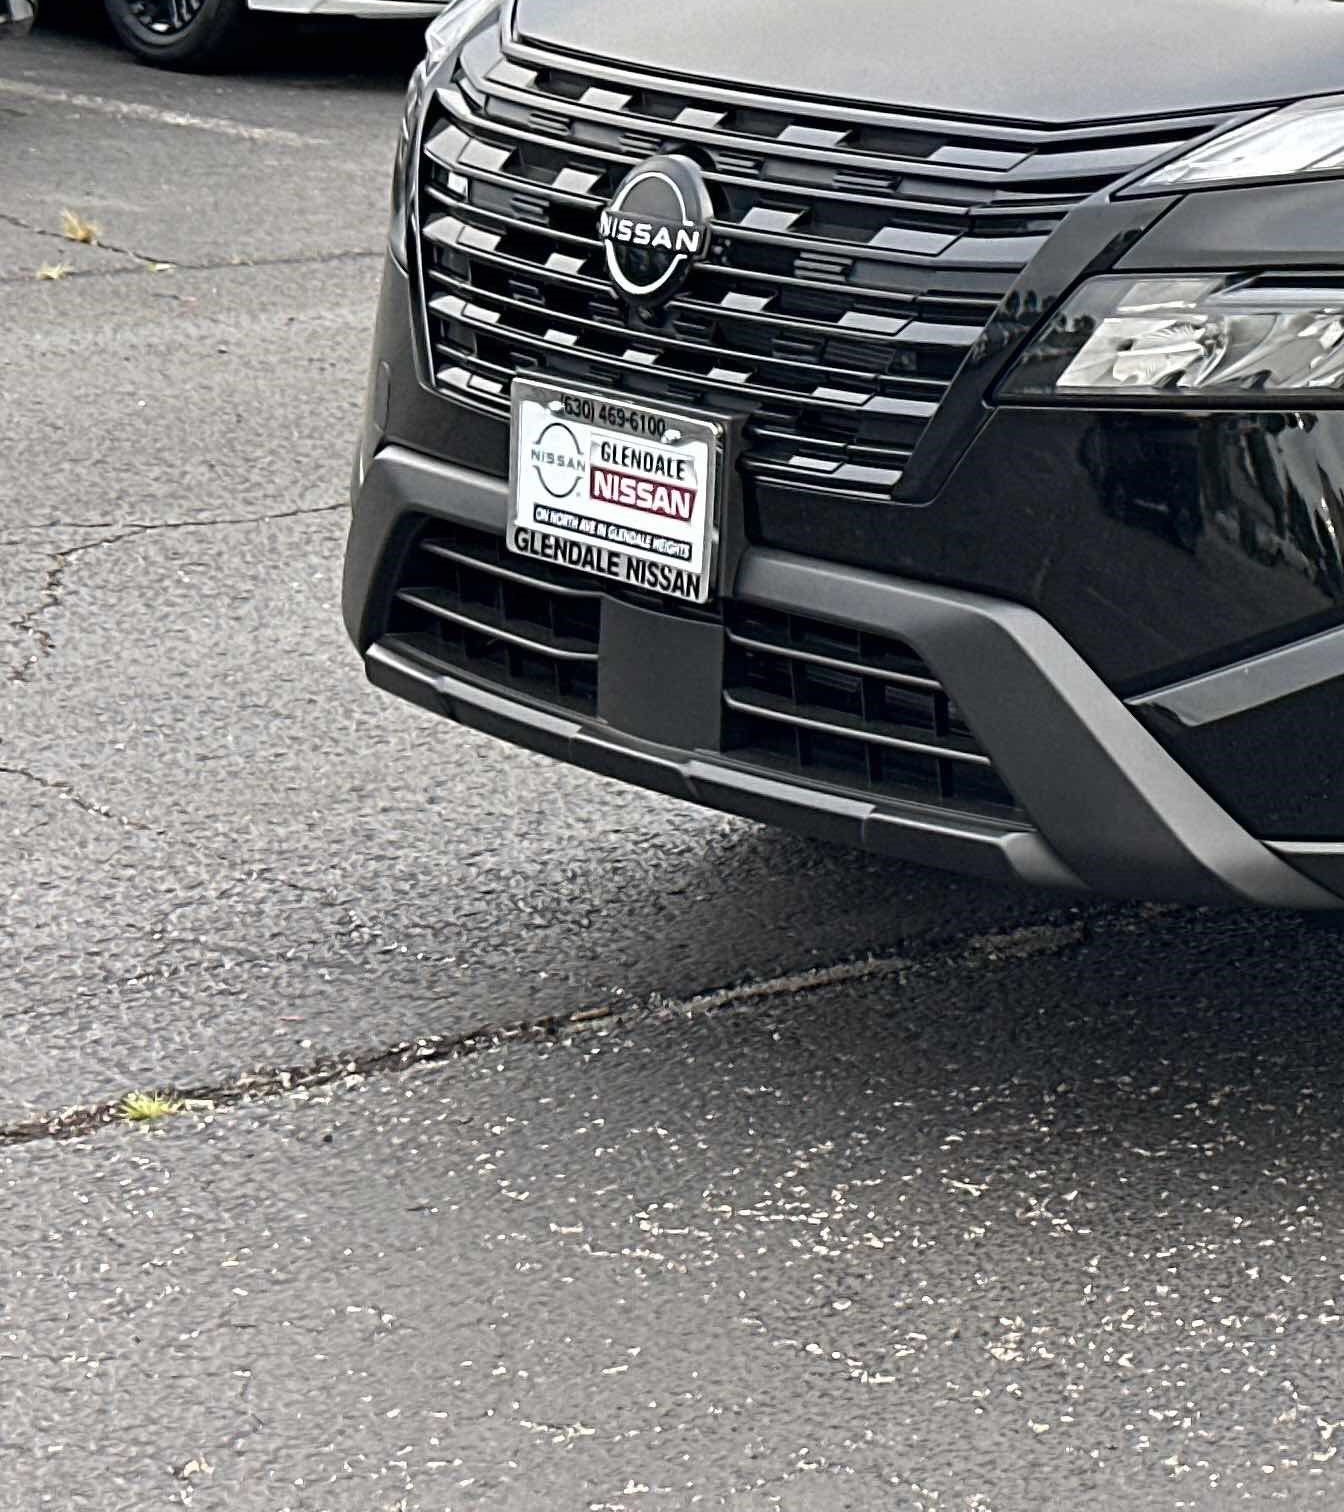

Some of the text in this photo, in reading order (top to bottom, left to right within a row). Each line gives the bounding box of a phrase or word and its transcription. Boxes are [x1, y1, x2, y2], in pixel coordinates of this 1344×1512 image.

[600, 210, 700, 253] NISSAN
[599, 407, 666, 437] 469-6100
[531, 448, 586, 473] NISSAN
[601, 441, 687, 481] GLENDALE
[593, 471, 692, 519] NISSAN
[579, 519, 596, 535] AVE
[607, 526, 651, 547] GLENDALE
[514, 526, 701, 601] GLENDALE NISSAN
